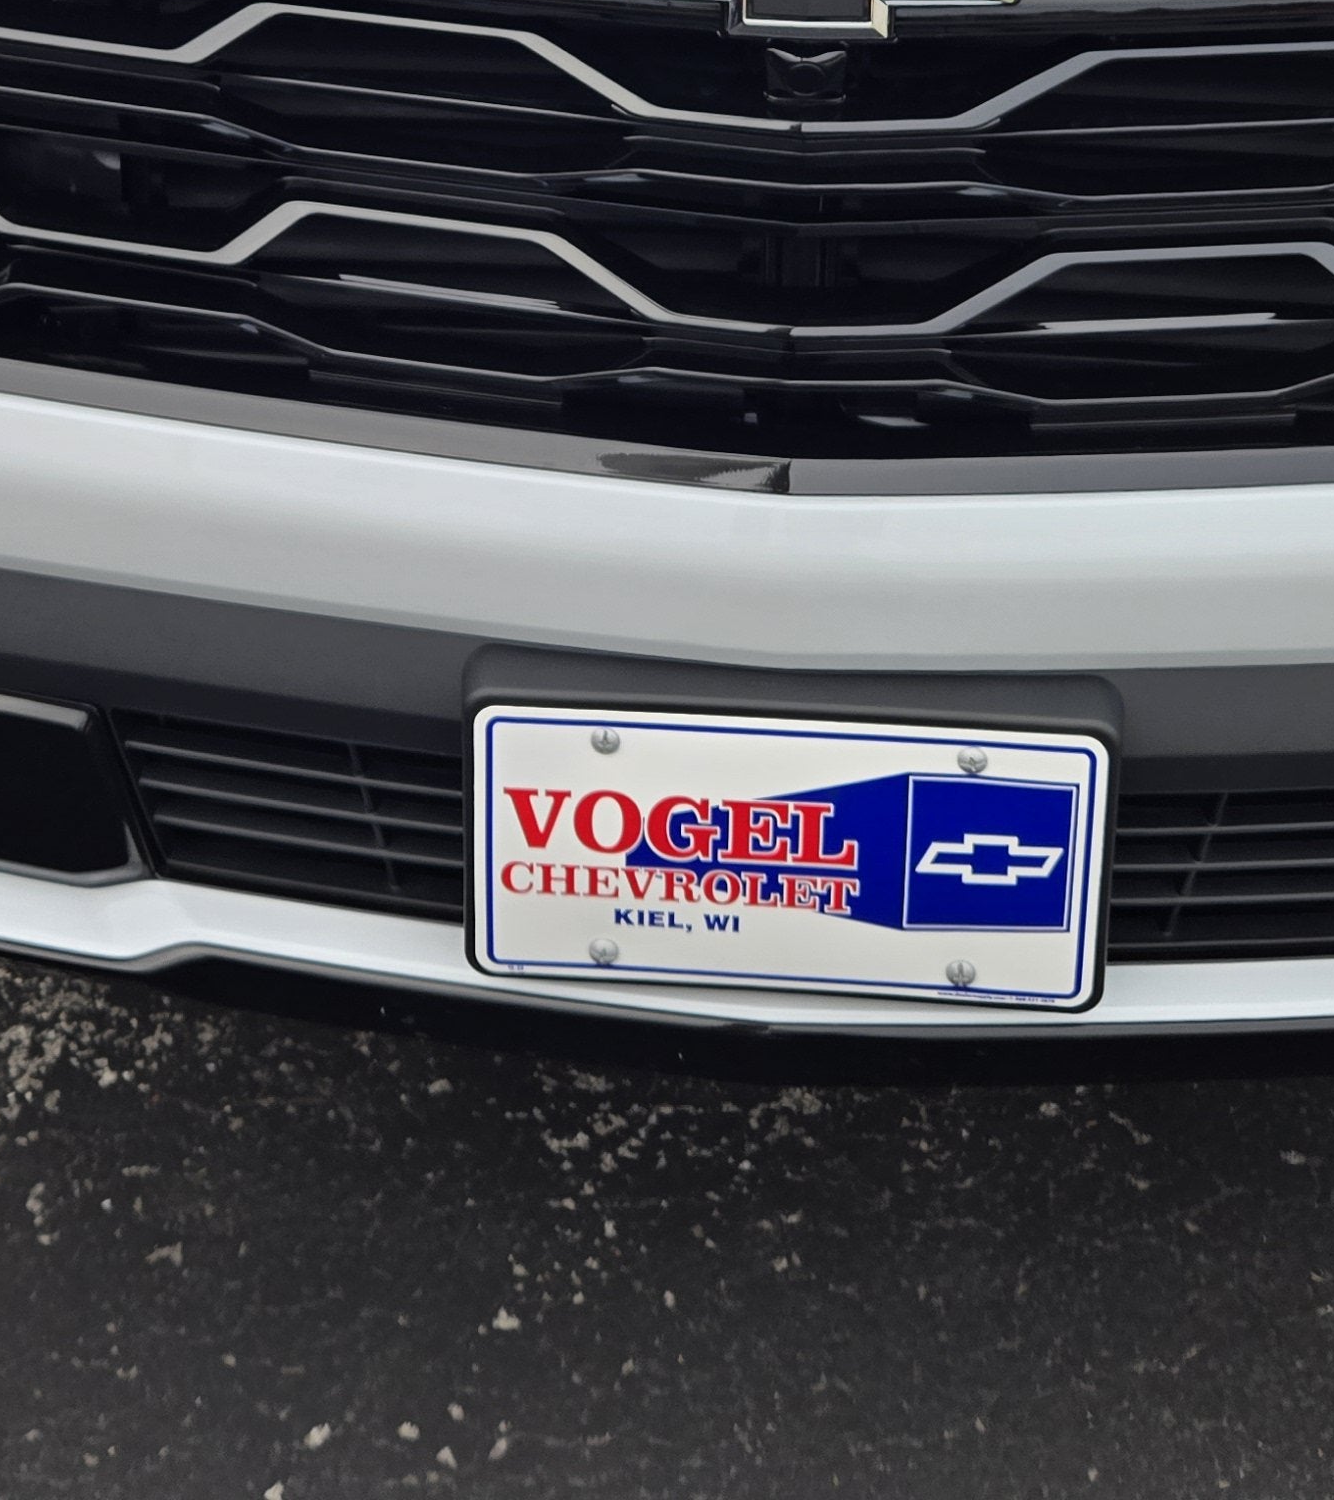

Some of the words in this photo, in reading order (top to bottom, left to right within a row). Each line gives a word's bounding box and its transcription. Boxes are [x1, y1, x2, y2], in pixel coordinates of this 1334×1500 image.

[503, 787, 857, 869] VOGEL
[500, 860, 860, 915] CHEVROLET
[614, 908, 694, 932] KIEL,
[703, 914, 741, 933] WI
